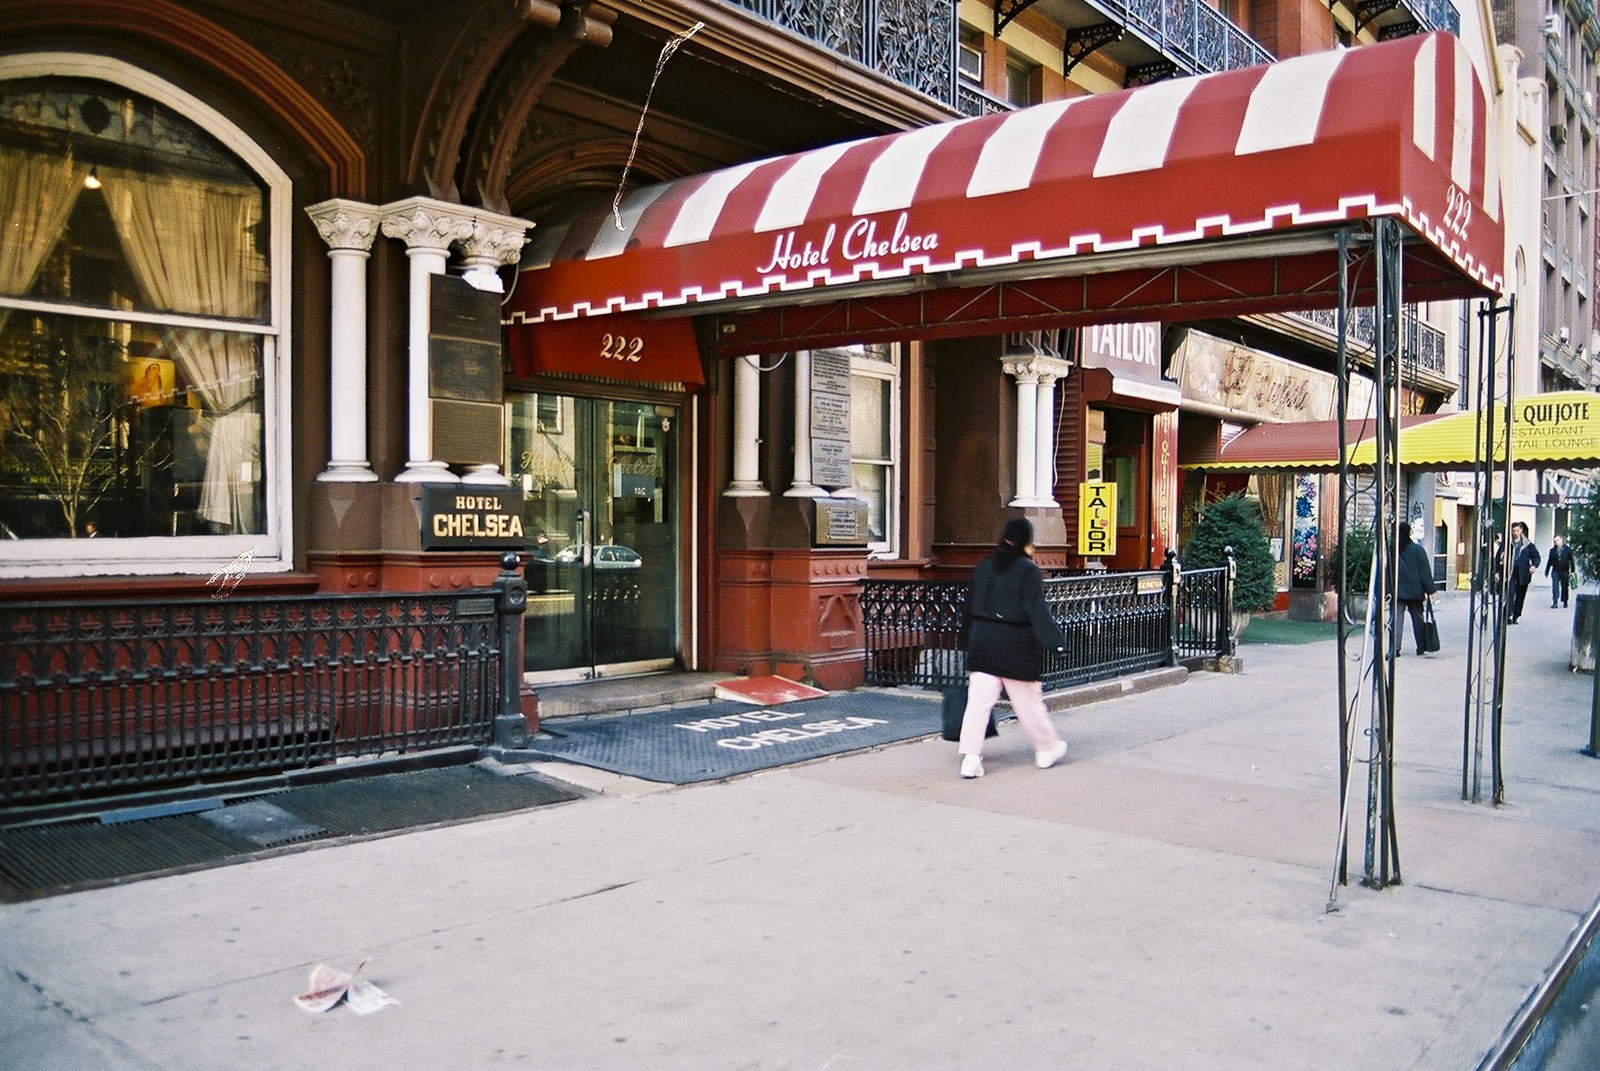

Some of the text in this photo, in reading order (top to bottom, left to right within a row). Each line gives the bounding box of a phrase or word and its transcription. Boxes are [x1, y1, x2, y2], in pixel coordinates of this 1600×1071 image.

[1443, 184, 1471, 241] 222
[757, 212, 938, 273] Hotel Chelsea
[601, 333, 643, 362] 222
[1091, 322, 1155, 366] TAILOR
[1523, 402, 1589, 426] QUIJOTE
[1506, 426, 1585, 437] ESTAURANT
[1545, 437, 1597, 449] LOUNGE
[455, 496, 502, 510] HOTEL
[433, 513, 523, 537] CHELSEA
[1088, 486, 1107, 552] TAILOR
[674, 709, 806, 732] HOTEL
[716, 716, 889, 751] CHELSEA
